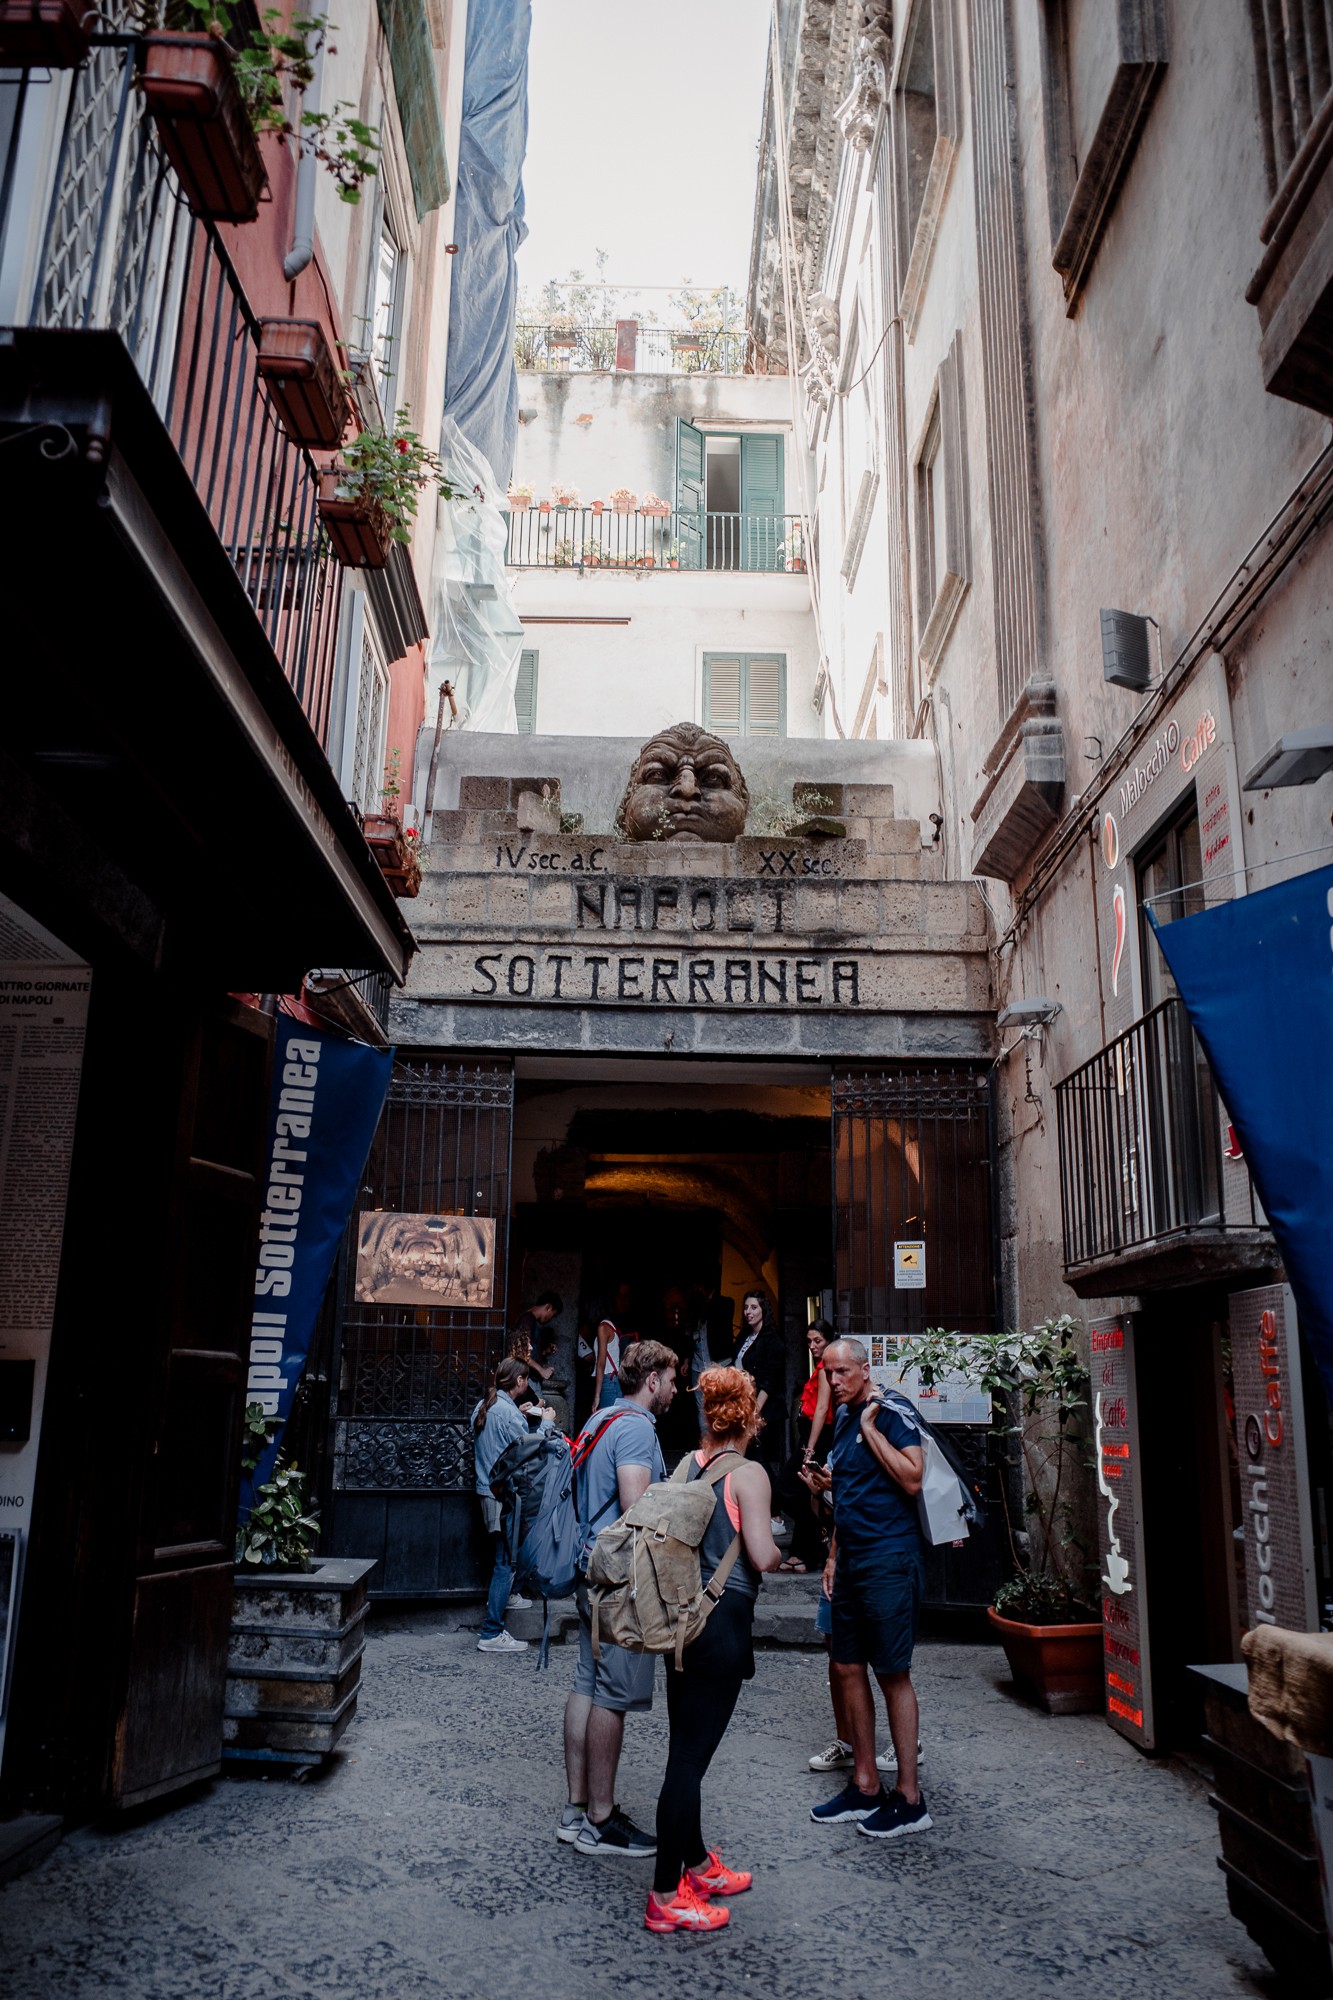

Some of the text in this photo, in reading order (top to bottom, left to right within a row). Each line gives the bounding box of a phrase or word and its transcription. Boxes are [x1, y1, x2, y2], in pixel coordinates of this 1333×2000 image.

[1179, 709, 1216, 772] Caffè
[495, 846, 527, 868] IV
[528, 851, 567, 871] sec.
[758, 850, 839, 876] XX sec.
[577, 884, 785, 933] NAPOLI
[34, 981, 90, 991] GIORNATE
[472, 952, 861, 1006] SOTTERRANEA
[12, 995, 53, 1005] NAPOLI
[243, 1037, 322, 1444] apoli Sotterranea
[1091, 1327, 1124, 1355] Emporio
[1102, 1362, 1114, 1386] del
[1258, 1309, 1284, 1448] Caffè
[1103, 1398, 1126, 1427] Caffè
[1104, 1597, 1129, 1629] Coffee
